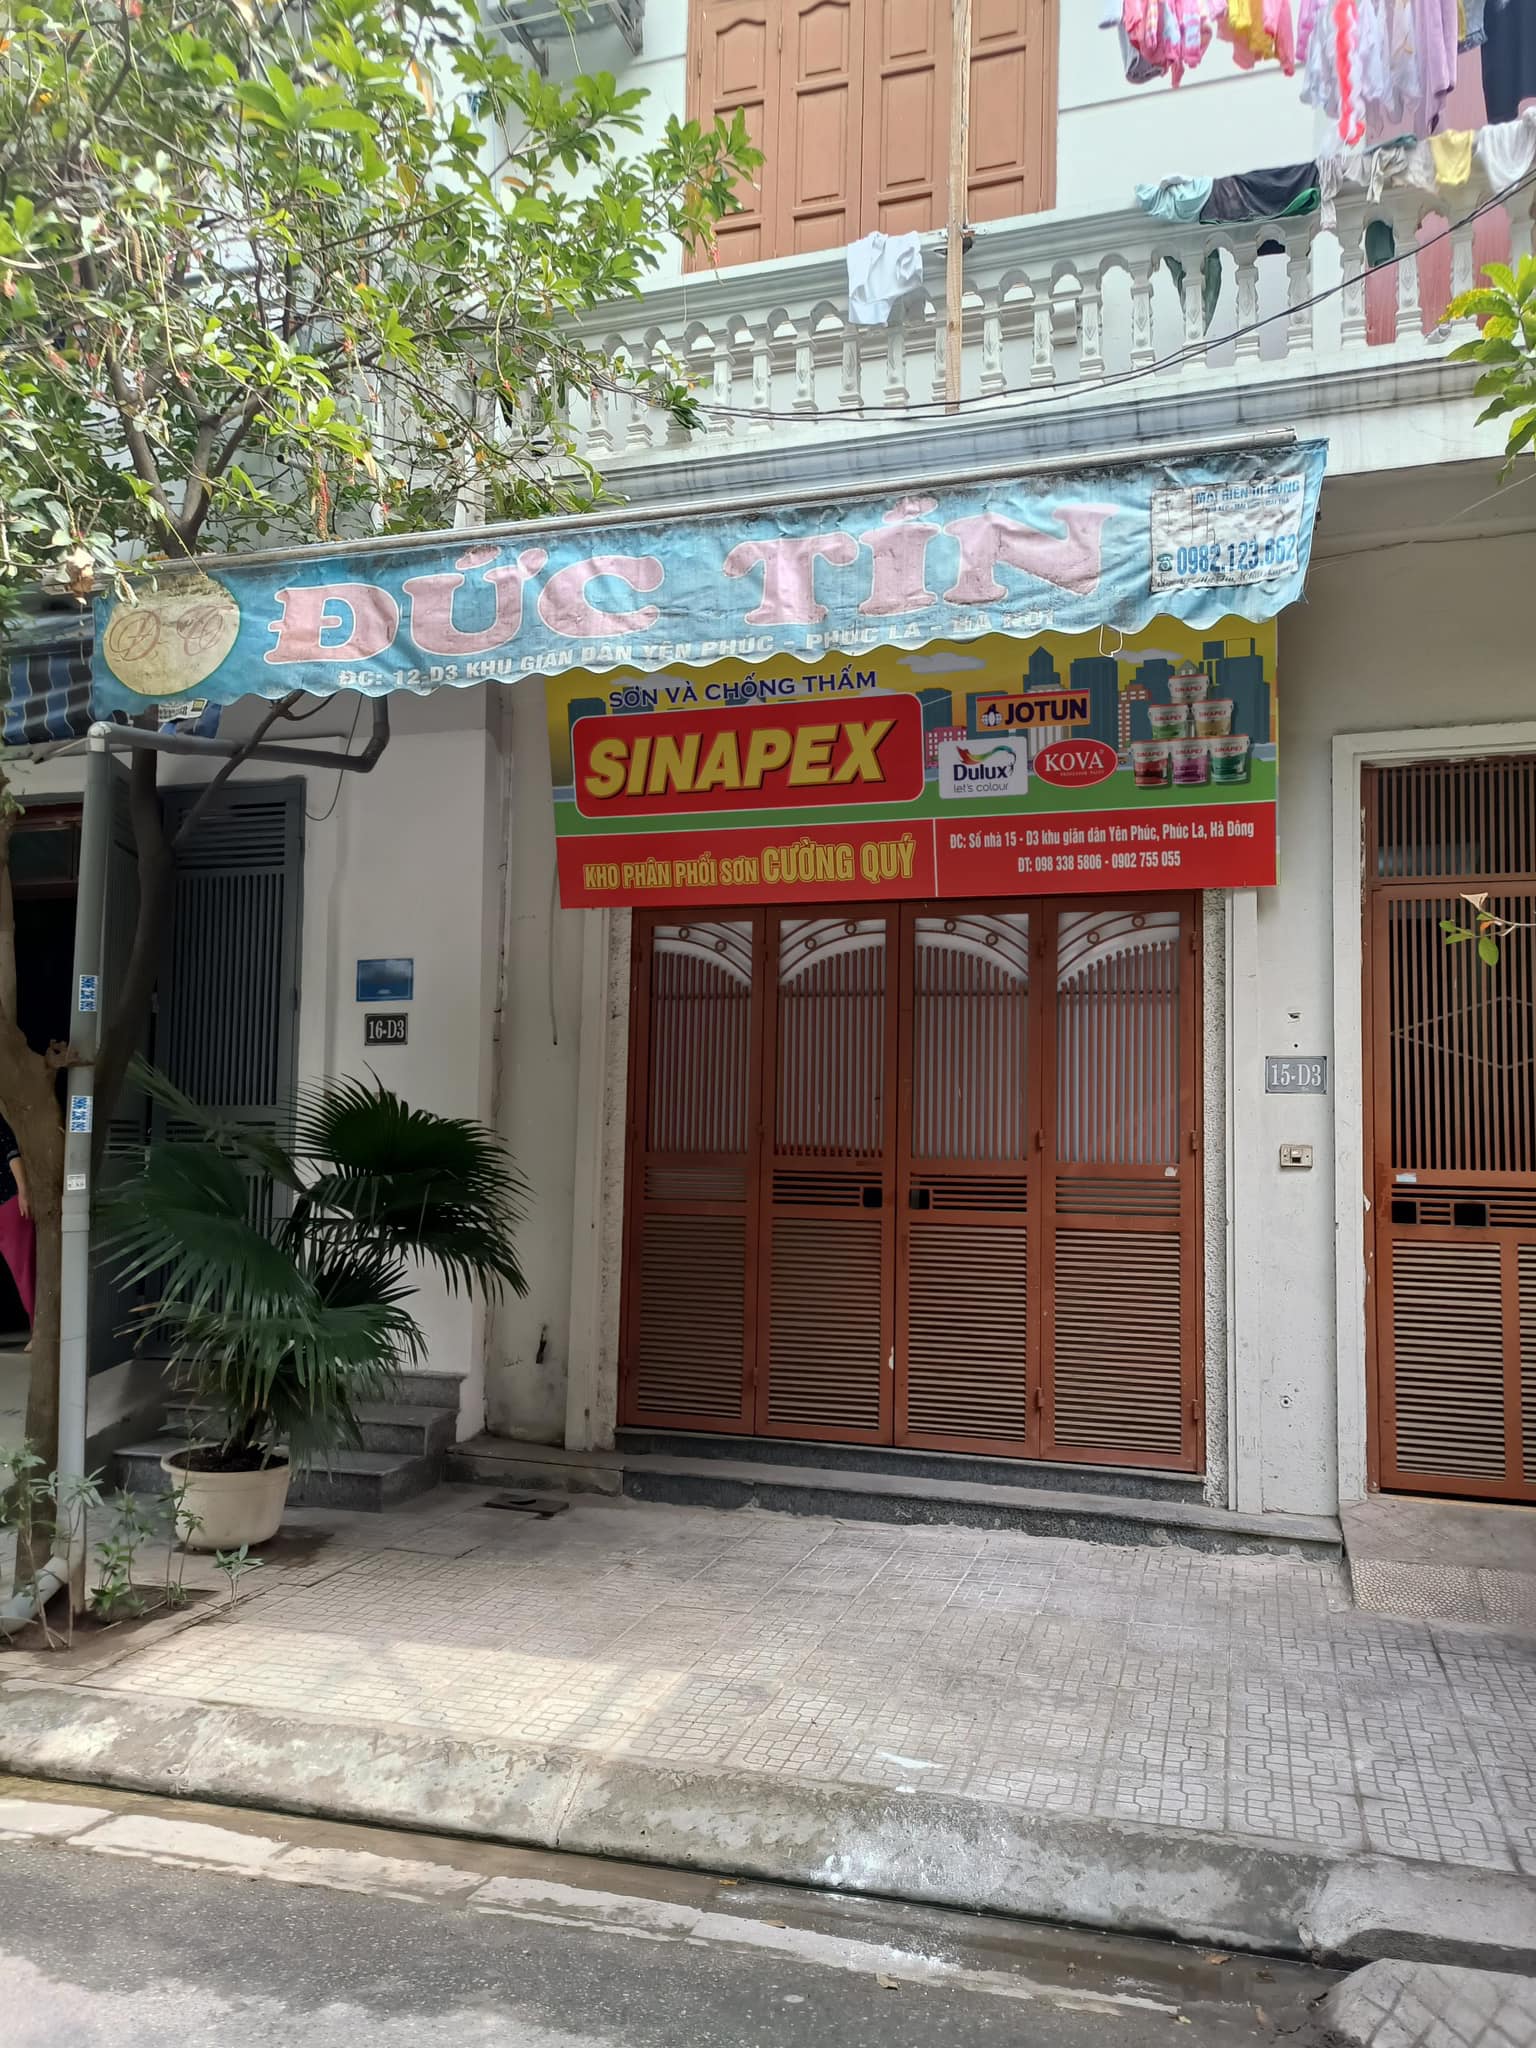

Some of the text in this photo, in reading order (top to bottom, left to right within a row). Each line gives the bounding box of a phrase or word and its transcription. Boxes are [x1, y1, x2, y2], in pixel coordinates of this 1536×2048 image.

[264, 497, 1120, 665] ĐỨC TÍN
[466, 660, 512, 679] KHU
[581, 641, 633, 662] DÂN
[643, 638, 692, 661] YÊN
[702, 634, 774, 658] PHÚC
[806, 624, 879, 650] PHÚC
[888, 622, 922, 641] LA
[609, 664, 876, 708] SƠN VÀ CHỐNG THẤM
[1005, 698, 1088, 726] JOTUN
[585, 718, 898, 800] SINAPEX
[953, 763, 1009, 781] Dulux
[1045, 751, 1104, 771] KOVA
[953, 782, 1009, 793] let's colour
[950, 832, 967, 849] ĐC:
[969, 829, 982, 848] Số
[984, 831, 1002, 848] nhà
[1004, 831, 1017, 847] 15
[1026, 830, 1039, 846] D3
[1042, 829, 1060, 845] khu
[1087, 826, 1106, 843] dân
[1108, 825, 1128, 842] Yên
[1130, 823, 1160, 842] Phúc,
[1162, 823, 1189, 840] Phúc
[1191, 821, 1207, 839] La,
[1210, 820, 1224, 838] Hà
[1227, 819, 1255, 838] Đông
[584, 832, 916, 890] KHO PHÂN PHỔI SƠN CƯỜNG QUÝ
[1018, 857, 1032, 873] ĐT:
[1035, 856, 1054, 872] 098
[1056, 855, 1075, 871] 338
[1077, 854, 1102, 870] 5806
[1112, 853, 1137, 869] 0902
[1139, 852, 1159, 867] 755
[1161, 851, 1180, 866] 055
[368, 1019, 405, 1039] 16-D3
[1271, 1062, 1322, 1087] 15-D3
